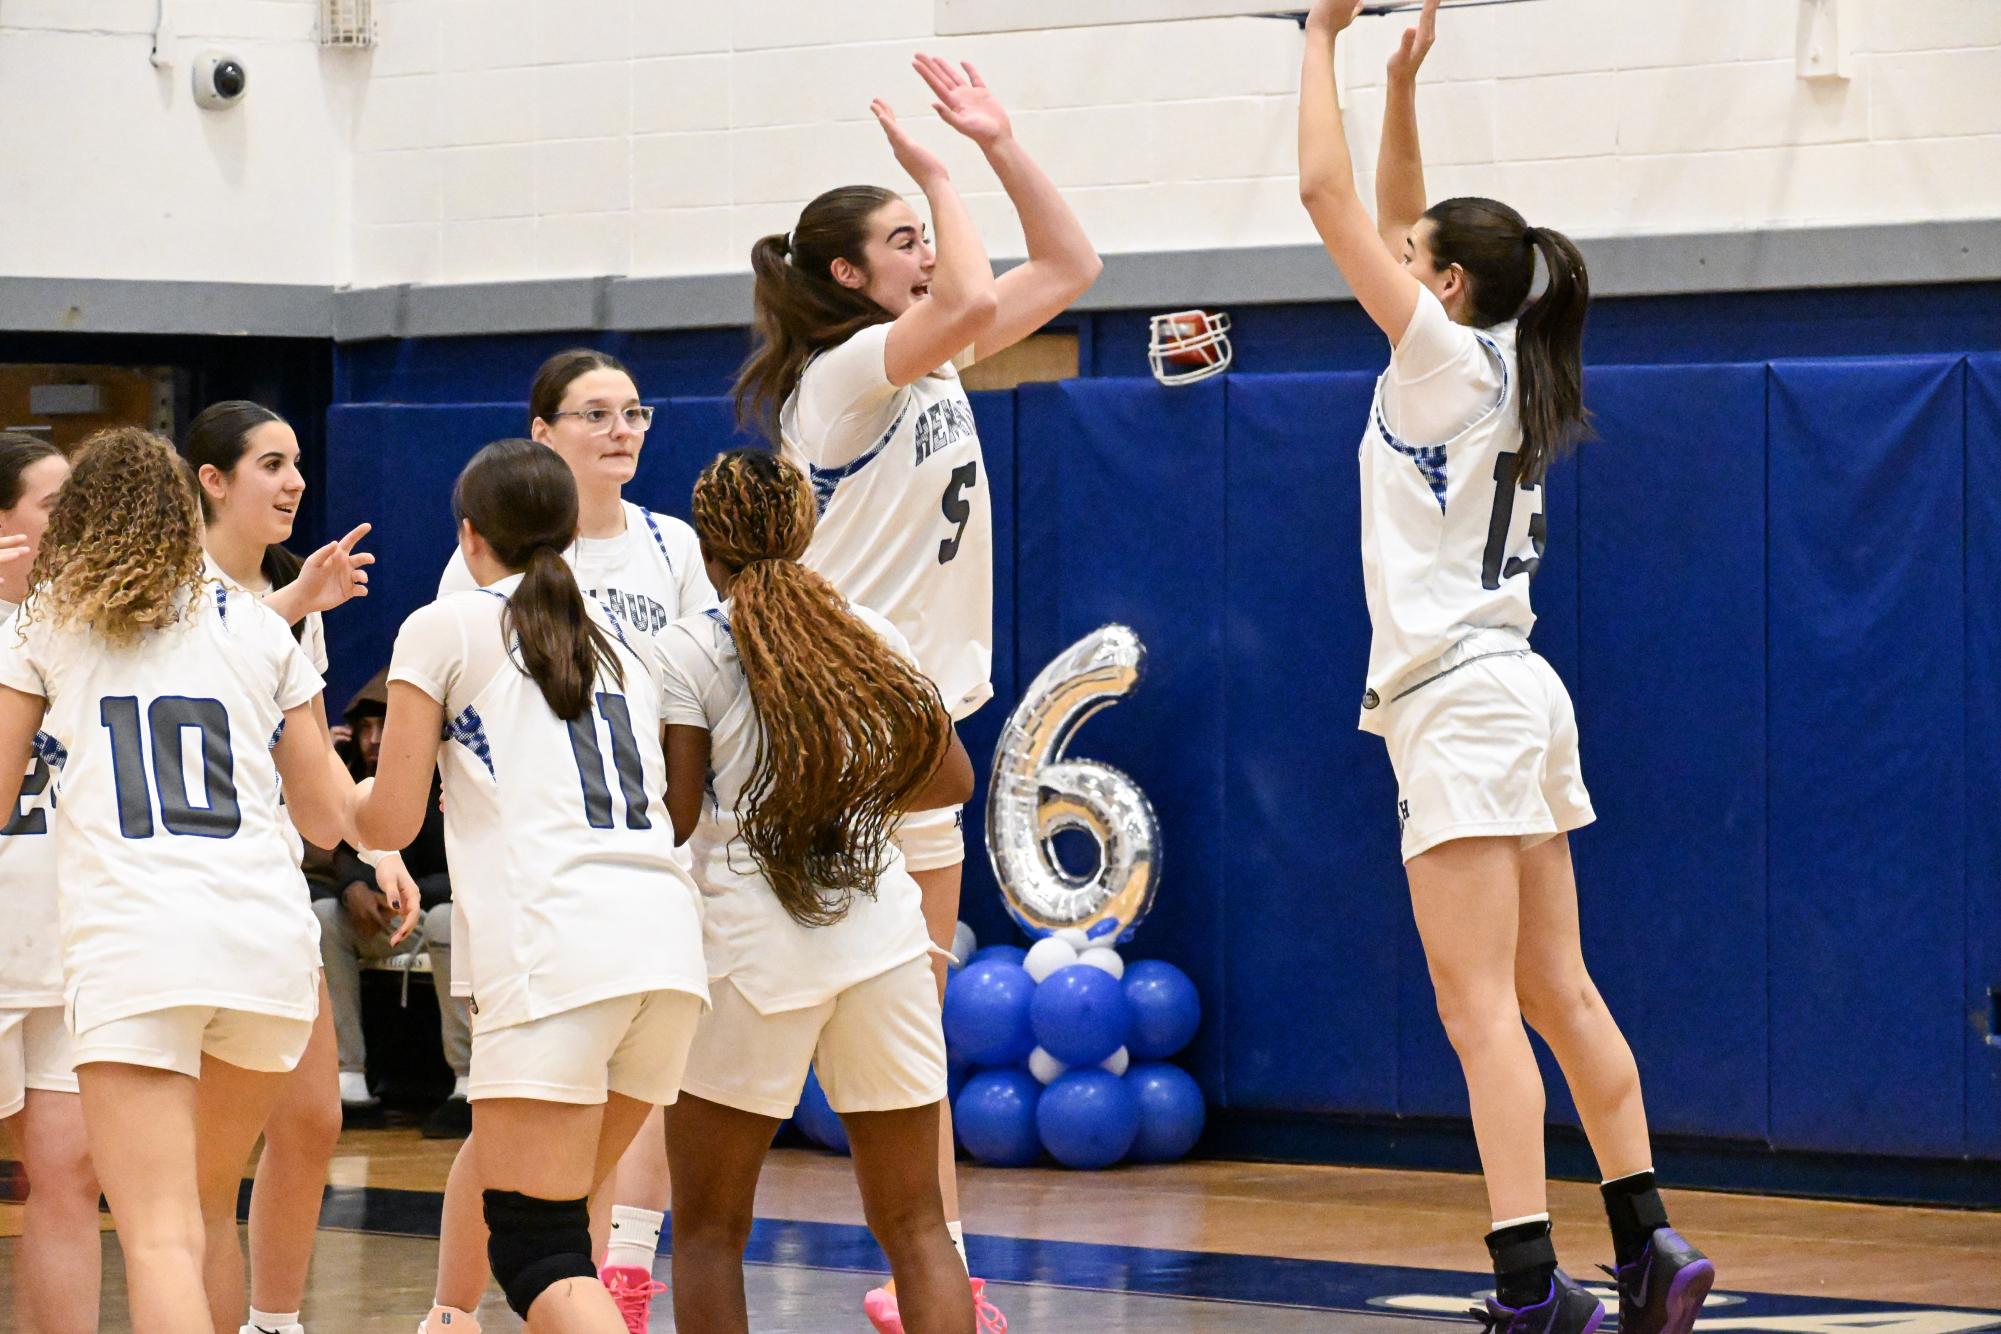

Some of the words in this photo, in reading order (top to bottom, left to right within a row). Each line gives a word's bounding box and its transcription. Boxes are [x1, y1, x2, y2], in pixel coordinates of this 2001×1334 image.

[938, 460, 977, 565] 5
[1481, 451, 1546, 591] 13
[100, 695, 241, 839] 10
[565, 691, 652, 830] 11
[985, 622, 1163, 935] 6
